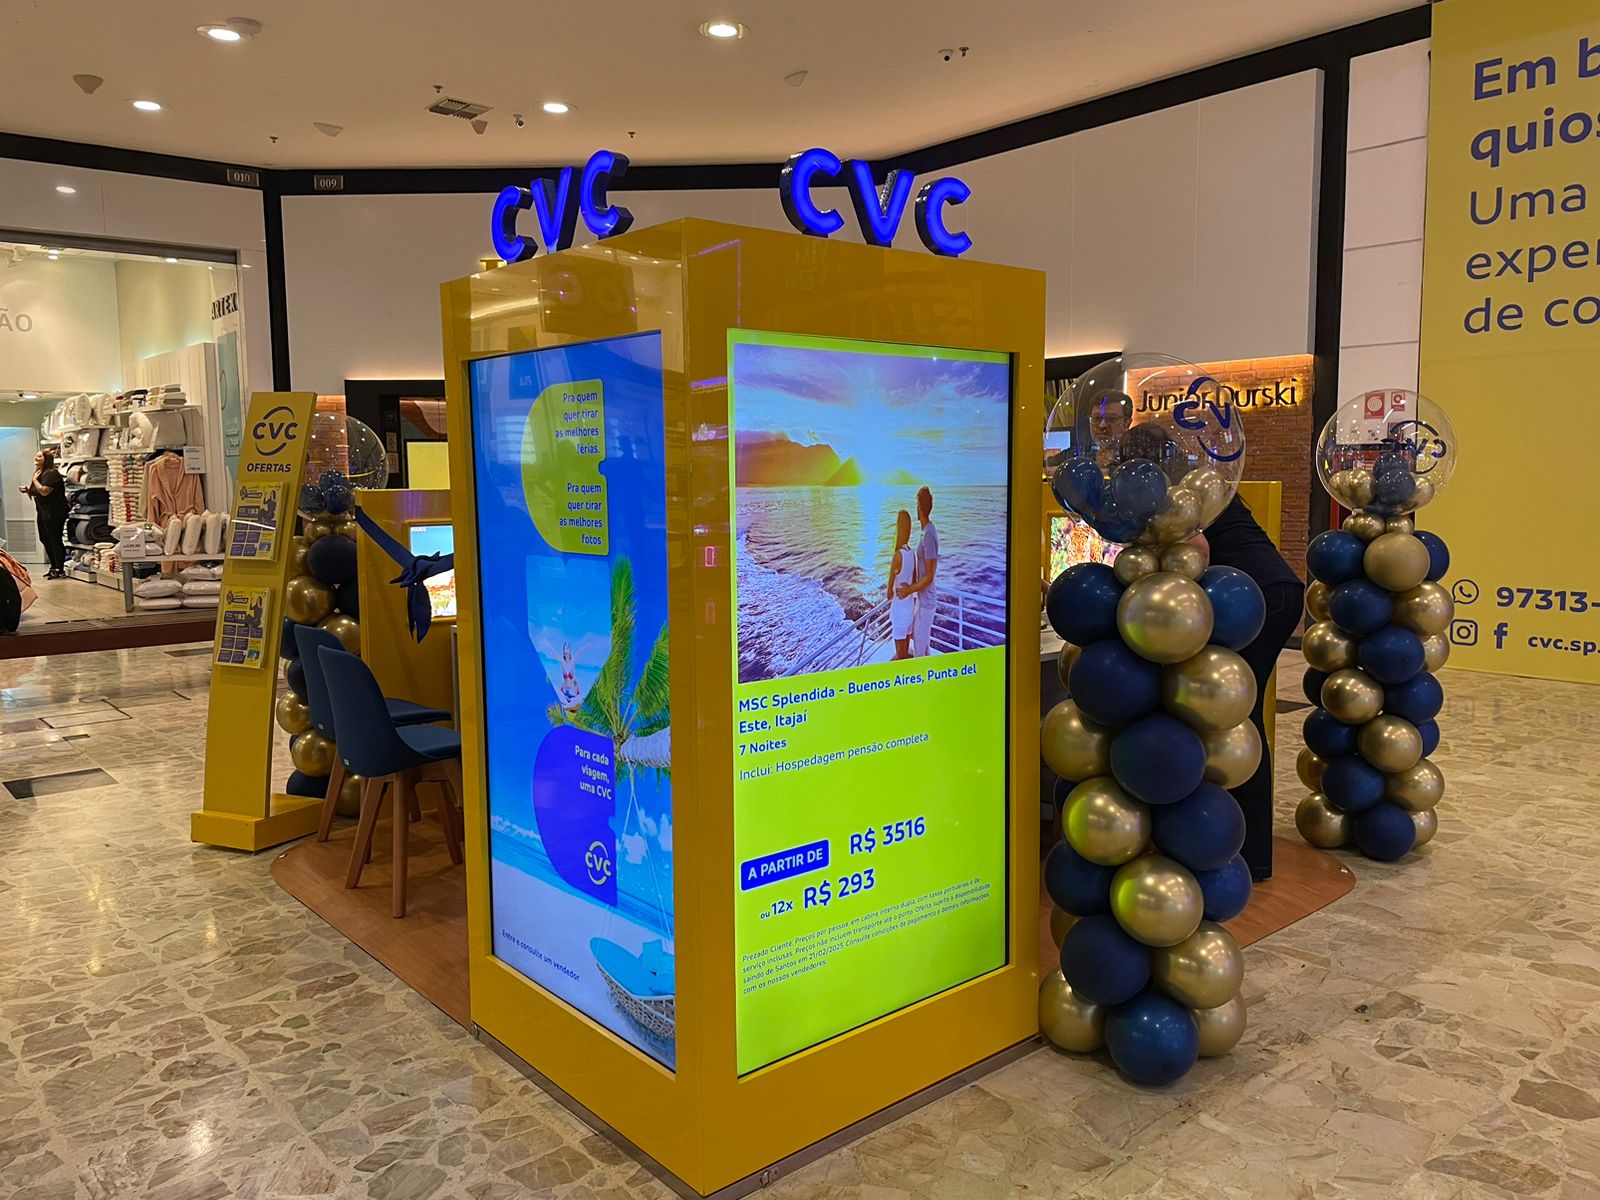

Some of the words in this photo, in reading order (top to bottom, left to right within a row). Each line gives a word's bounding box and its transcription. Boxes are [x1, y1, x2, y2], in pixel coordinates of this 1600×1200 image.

[1474, 55, 1556, 101] Em
[1470, 107, 1600, 168] quio
[234, 172, 251, 183] 010
[320, 179, 337, 188] 009
[491, 149, 634, 264] CVC
[779, 147, 973, 256] CVC
[1470, 183, 1586, 226] Uma
[1465, 238, 1600, 283] expe
[1463, 297, 1523, 335] de
[1544, 296, 1600, 327] co
[563, 393, 575, 403] Pra
[577, 392, 598, 404] quem
[1136, 387, 1212, 413] Junior
[563, 411, 580, 422] quer
[581, 409, 598, 419] tirar
[252, 422, 298, 440] CVC
[555, 430, 563, 438] as
[565, 427, 599, 437] melhores
[246, 462, 291, 473] OFERTAS
[567, 483, 579, 493] Pra
[581, 484, 602, 495] quem
[567, 501, 584, 511] quer
[585, 500, 602, 510] tirar
[560, 518, 567, 526] as
[569, 517, 603, 528] melhores
[739, 696, 768, 713] MSC
[772, 687, 835, 708] Splendida
[848, 680, 891, 694] Buenos
[894, 675, 925, 687] Aires,
[927, 668, 958, 681] Punta
[961, 663, 977, 675] del
[739, 720, 771, 734] Este,
[775, 709, 807, 728] Itajaí
[574, 745, 591, 760] Para
[592, 751, 610, 766] cada
[739, 745, 746, 756] 7
[749, 739, 787, 754] Noites
[740, 764, 773, 781] Inclui:
[776, 751, 845, 773] Hospedagem
[848, 742, 883, 760] pensão
[886, 733, 929, 750] completa
[581, 764, 610, 784] viagem,
[579, 781, 596, 795] uma
[596, 785, 612, 800] CVC
[849, 828, 877, 855] R$
[882, 816, 925, 846] 3516
[585, 851, 612, 877] CVC
[747, 867, 758, 881] A
[760, 852, 804, 877] PARTIR
[807, 848, 823, 863] DE
[760, 910, 771, 920] ou
[771, 900, 794, 915] 12x
[803, 880, 832, 909] R$
[838, 868, 875, 898] 293
[502, 929, 516, 944] Entre
[520, 940, 543, 960] consulte
[543, 955, 553, 966] um
[742, 949, 769, 962] Prezado
[795, 933, 815, 944] Preços
[816, 929, 827, 938] por
[742, 960, 766, 973] serviço
[795, 944, 816, 955] Preços
[816, 938, 828, 947] não
[828, 930, 852, 942] incluem
[853, 920, 882, 935] transporte
[742, 971, 765, 984] saindo
[765, 968, 774, 976] de
[775, 961, 797, 972] Santos
[798, 956, 808, 964] em
[845, 935, 871, 947] Consulte
[743, 985, 757, 995] com
[758, 981, 766, 989] os
[767, 974, 790, 985] nossos
